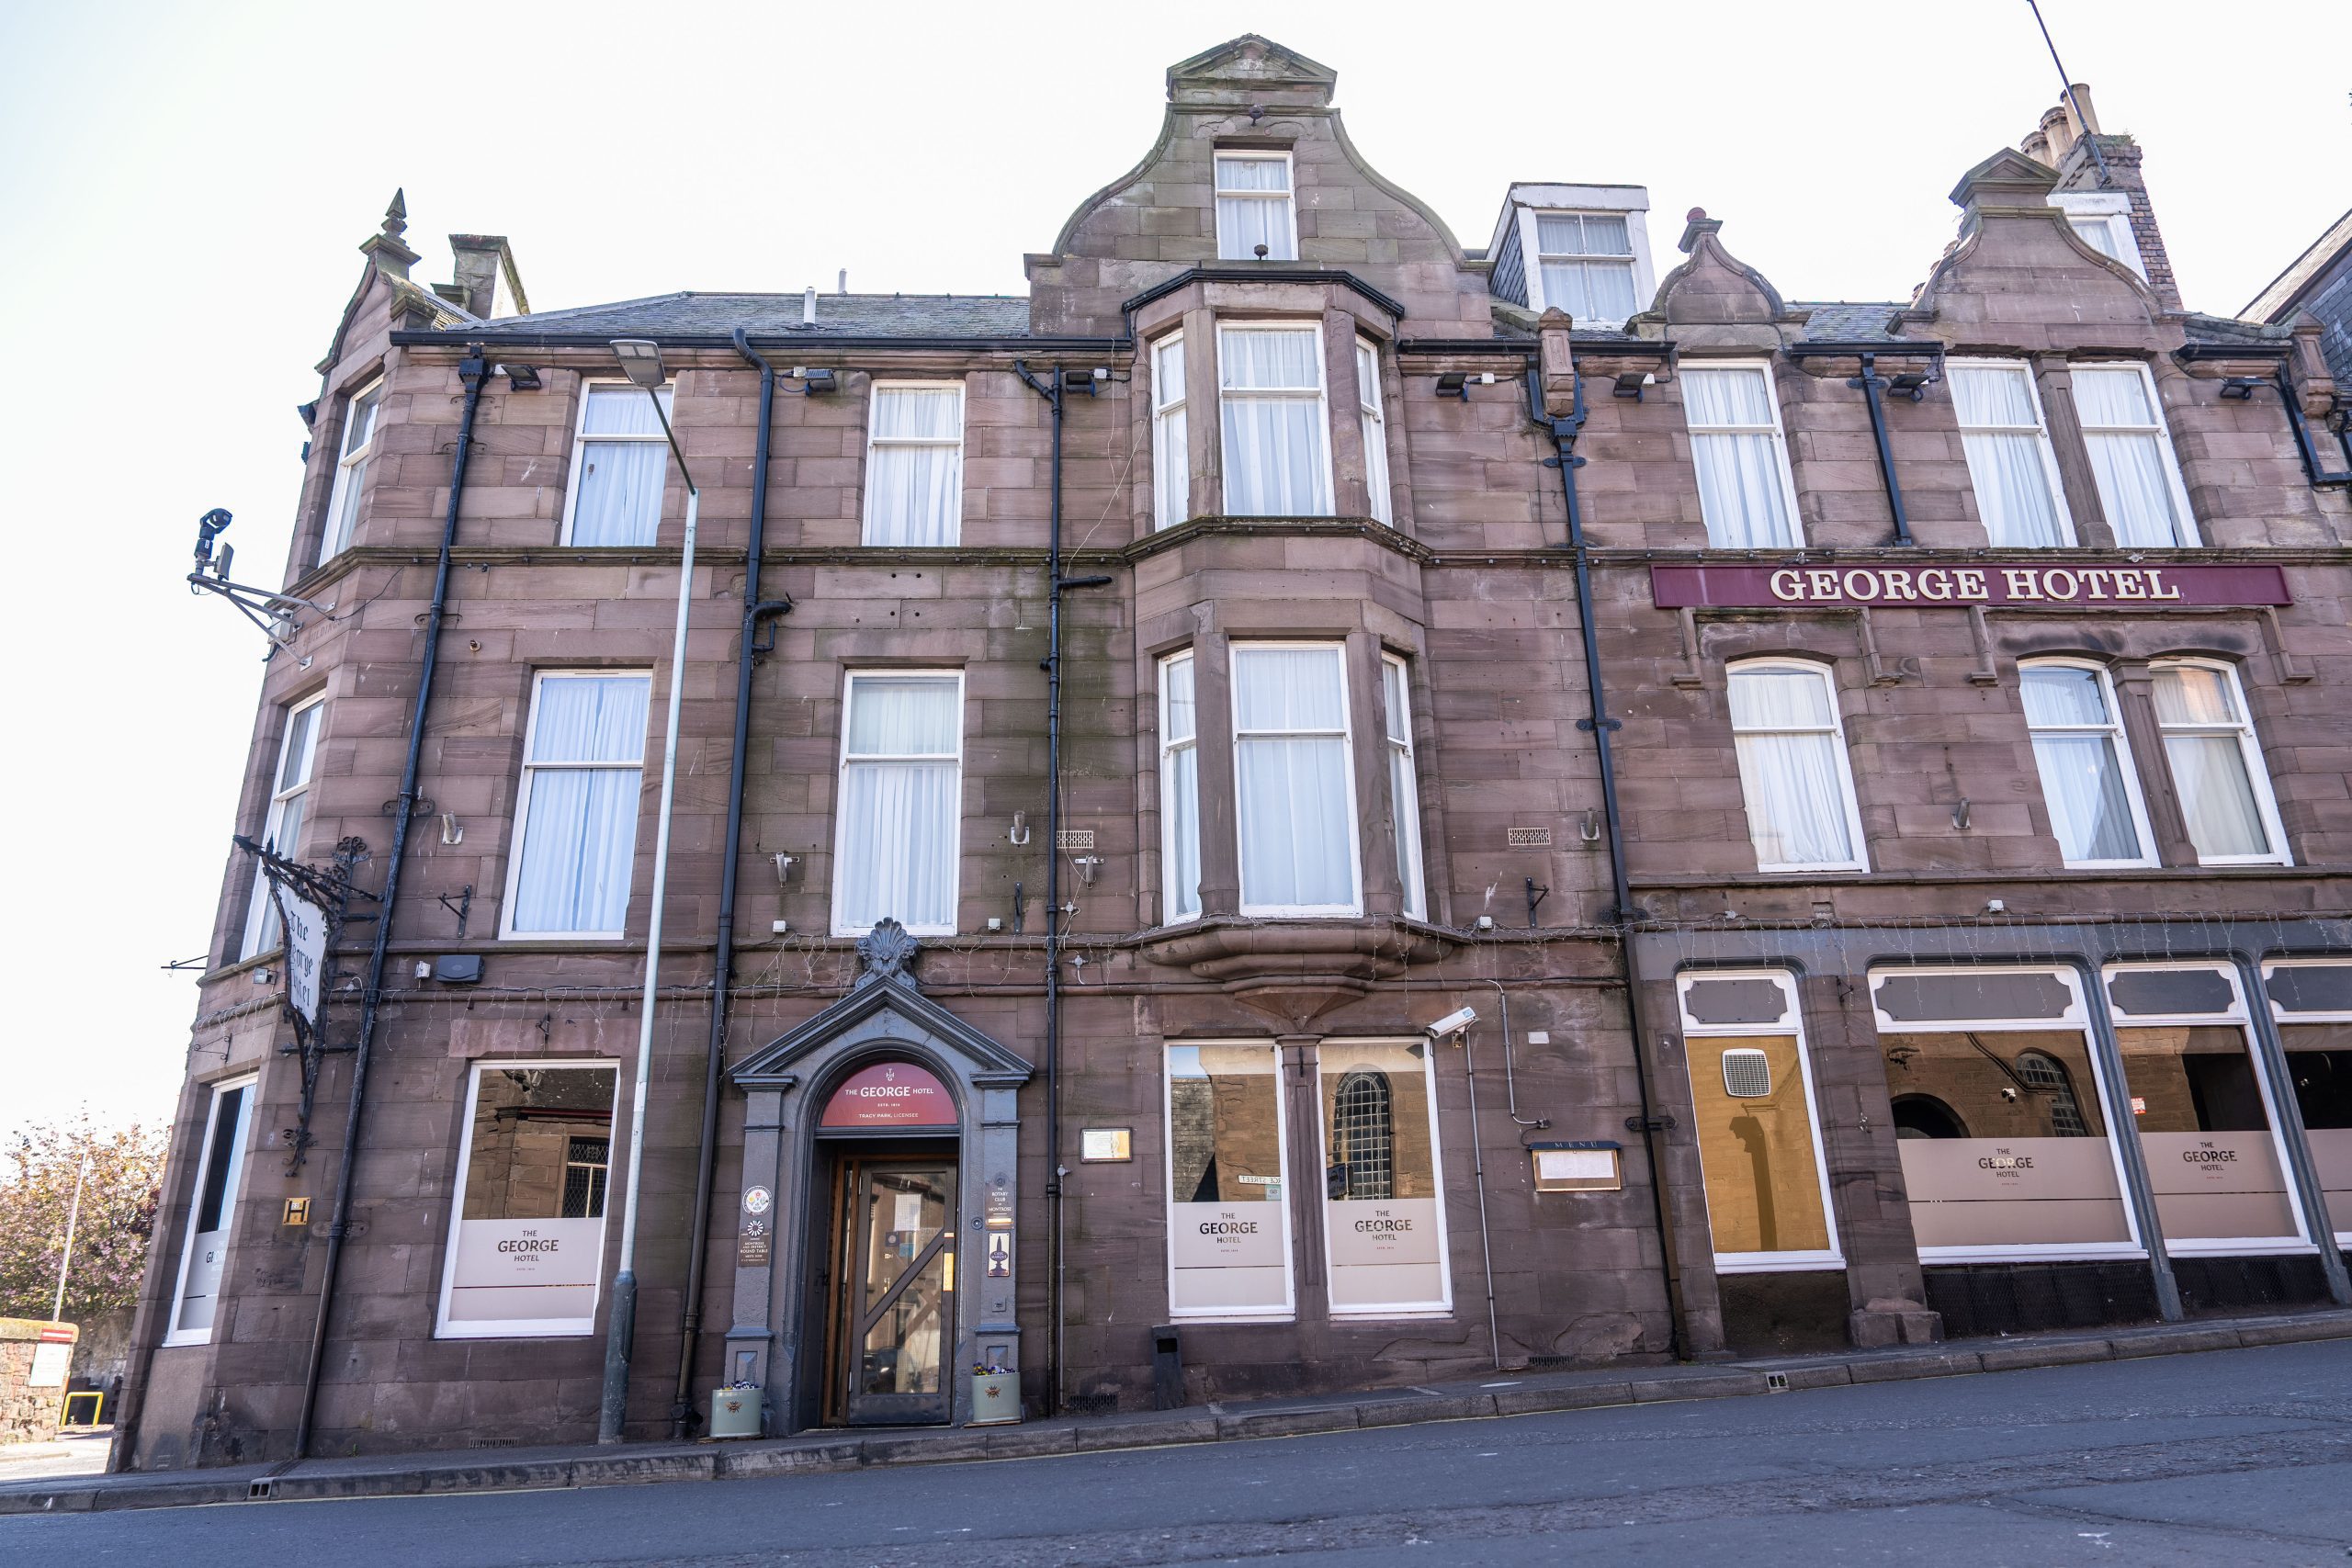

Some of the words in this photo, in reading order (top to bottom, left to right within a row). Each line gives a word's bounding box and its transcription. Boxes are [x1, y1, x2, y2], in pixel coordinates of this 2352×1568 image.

[1770, 569, 1989, 602] GEORGE
[2001, 568, 2180, 601] HOTEL
[291, 943, 313, 978] eorge
[860, 1086, 911, 1098] GEORGE
[1978, 1156, 2034, 1169] GEORGE
[2183, 1150, 2237, 1163] GEORGE
[286, 1200, 307, 1223] H
[1199, 1222, 1258, 1235] GEORGE
[1354, 1219, 1413, 1233] GEORGE
[497, 1239, 560, 1253] GEORGE
[514, 1254, 539, 1262] HOTEL
